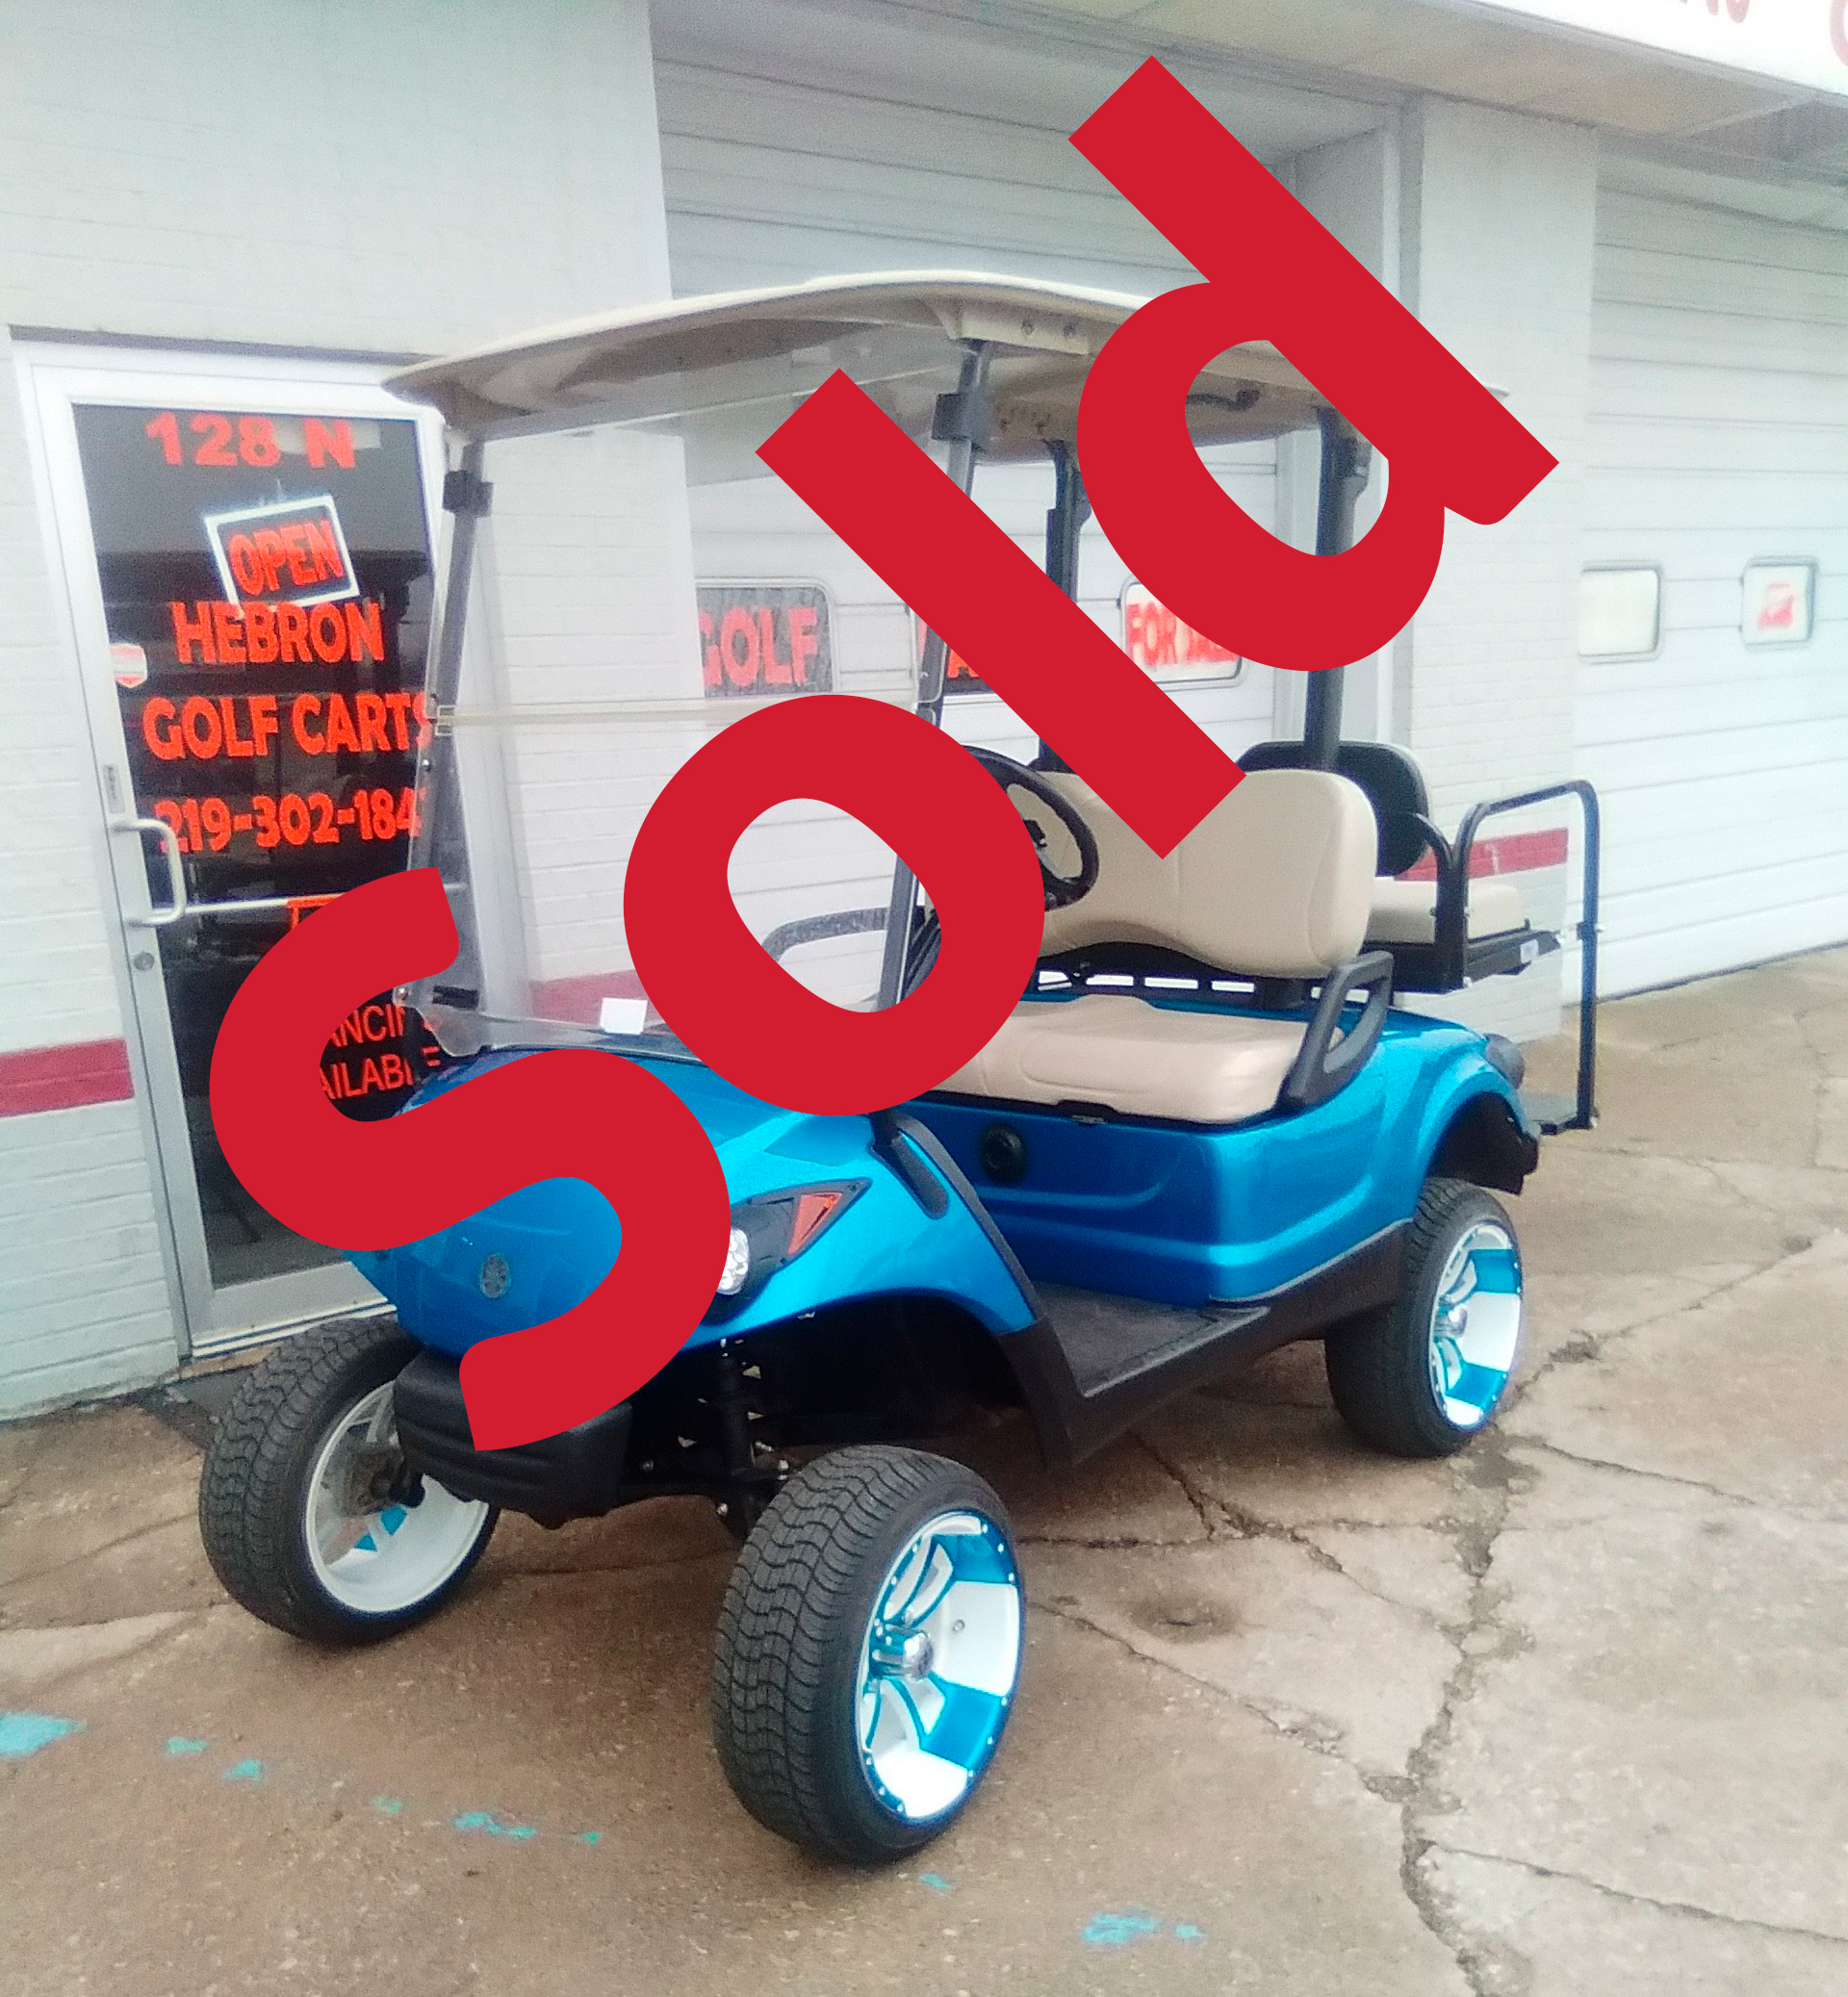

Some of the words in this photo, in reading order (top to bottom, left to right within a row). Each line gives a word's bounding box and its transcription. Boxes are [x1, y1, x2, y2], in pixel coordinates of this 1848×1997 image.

[145, 412, 280, 466] 128
[302, 417, 356, 469] N
[229, 520, 344, 594] OPEN
[171, 601, 385, 664] HEBRON
[142, 695, 279, 761] GOLF
[154, 787, 426, 854] 219-302-184
